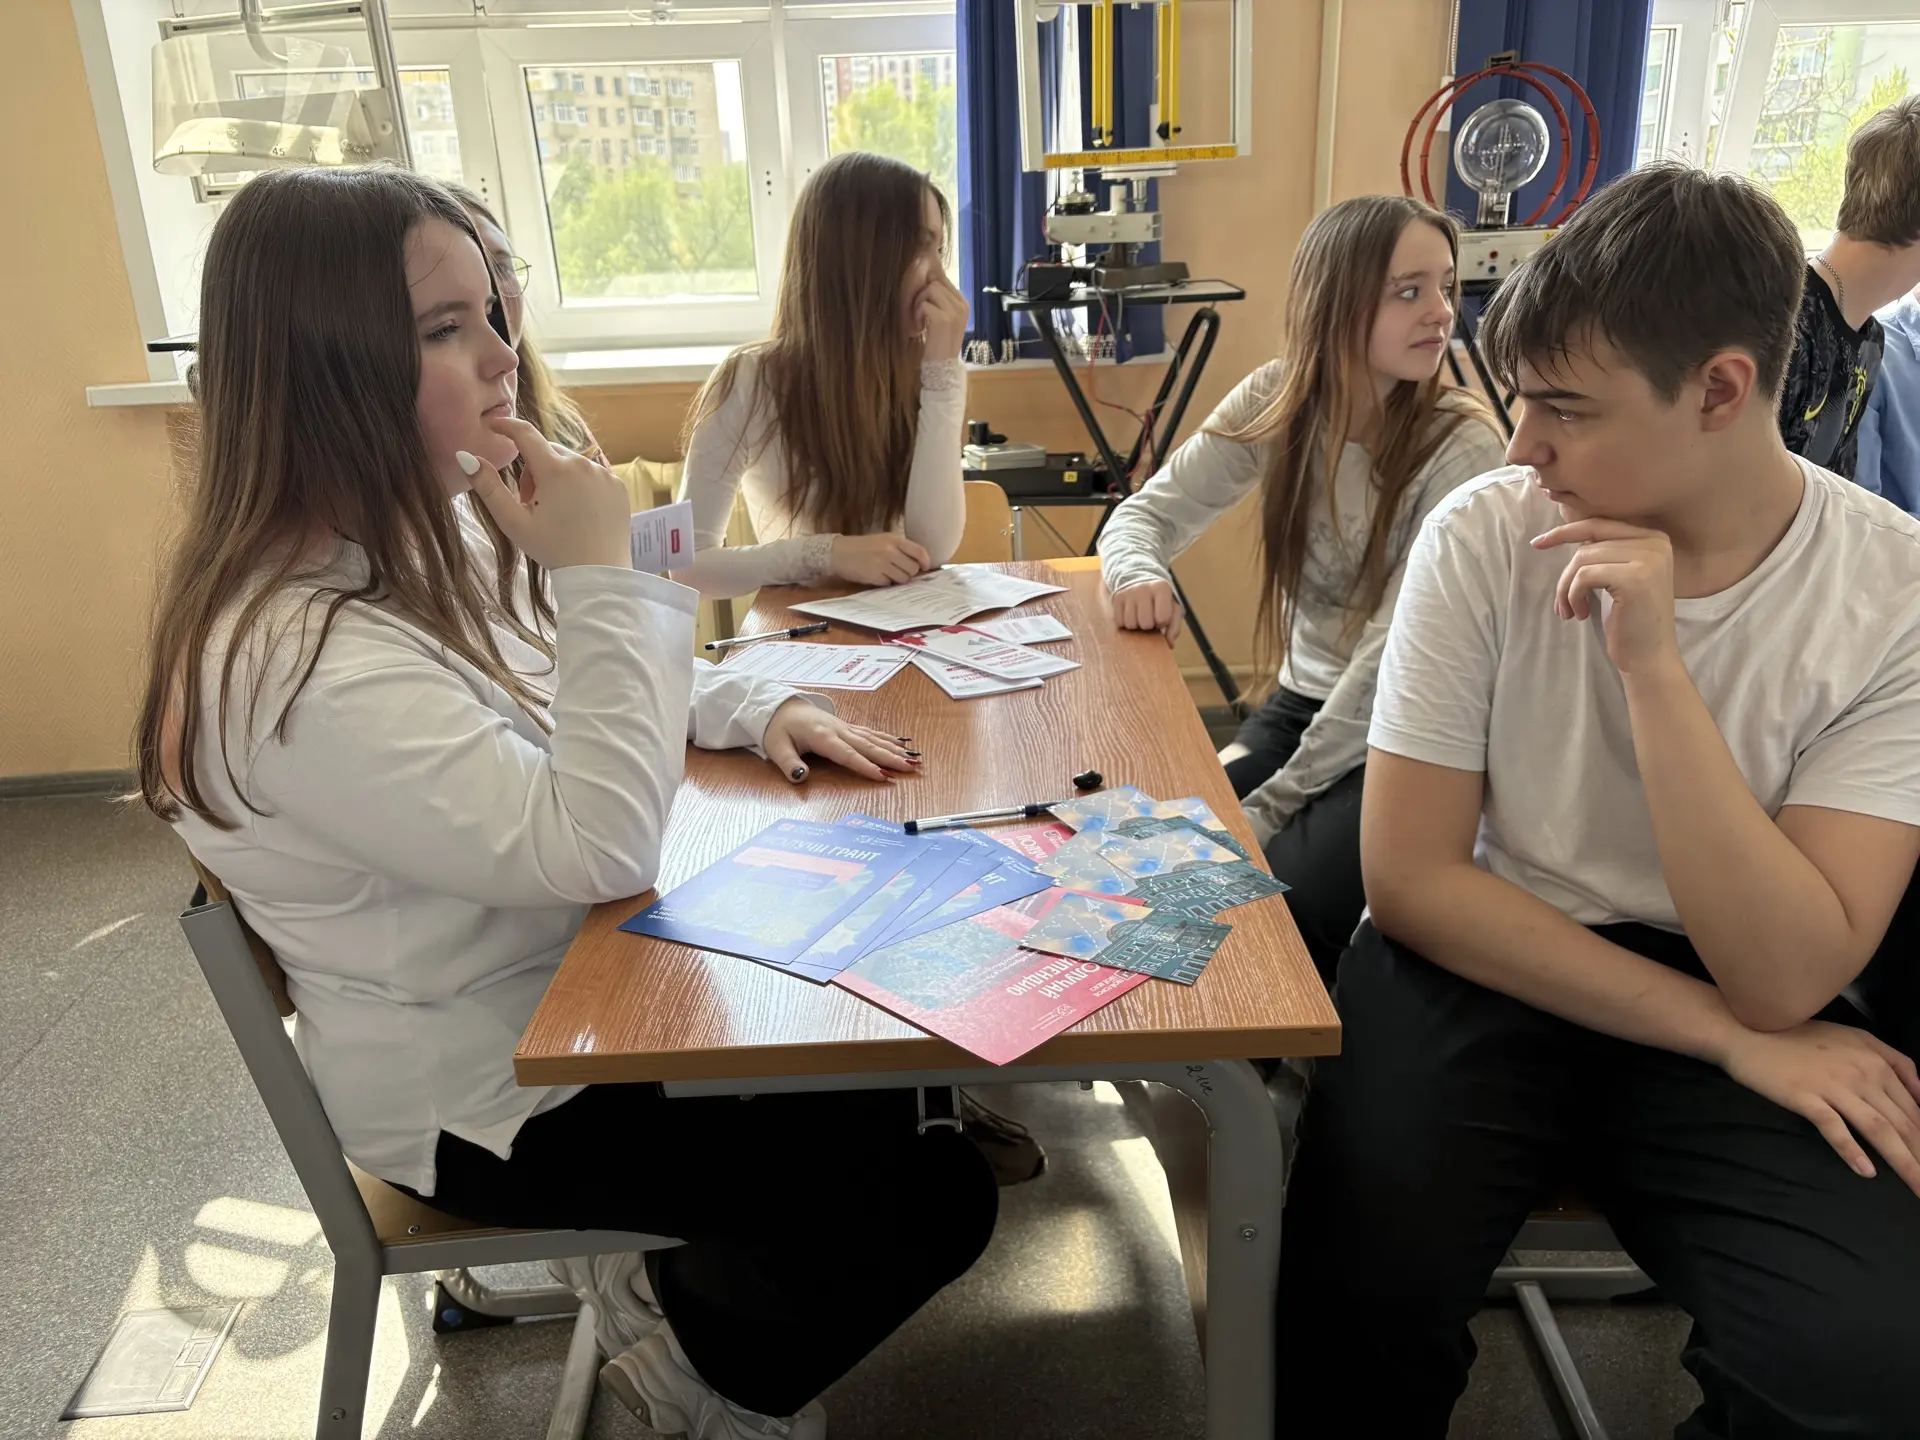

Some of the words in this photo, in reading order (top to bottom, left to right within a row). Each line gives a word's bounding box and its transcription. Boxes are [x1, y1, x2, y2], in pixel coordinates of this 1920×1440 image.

[272, 147, 286, 157] 45
[827, 846, 882, 861] ГРАНТ
[1006, 957, 1077, 996] ИПЕНДИЮ
[1038, 963, 1101, 999] ОЛУЧАЙ
